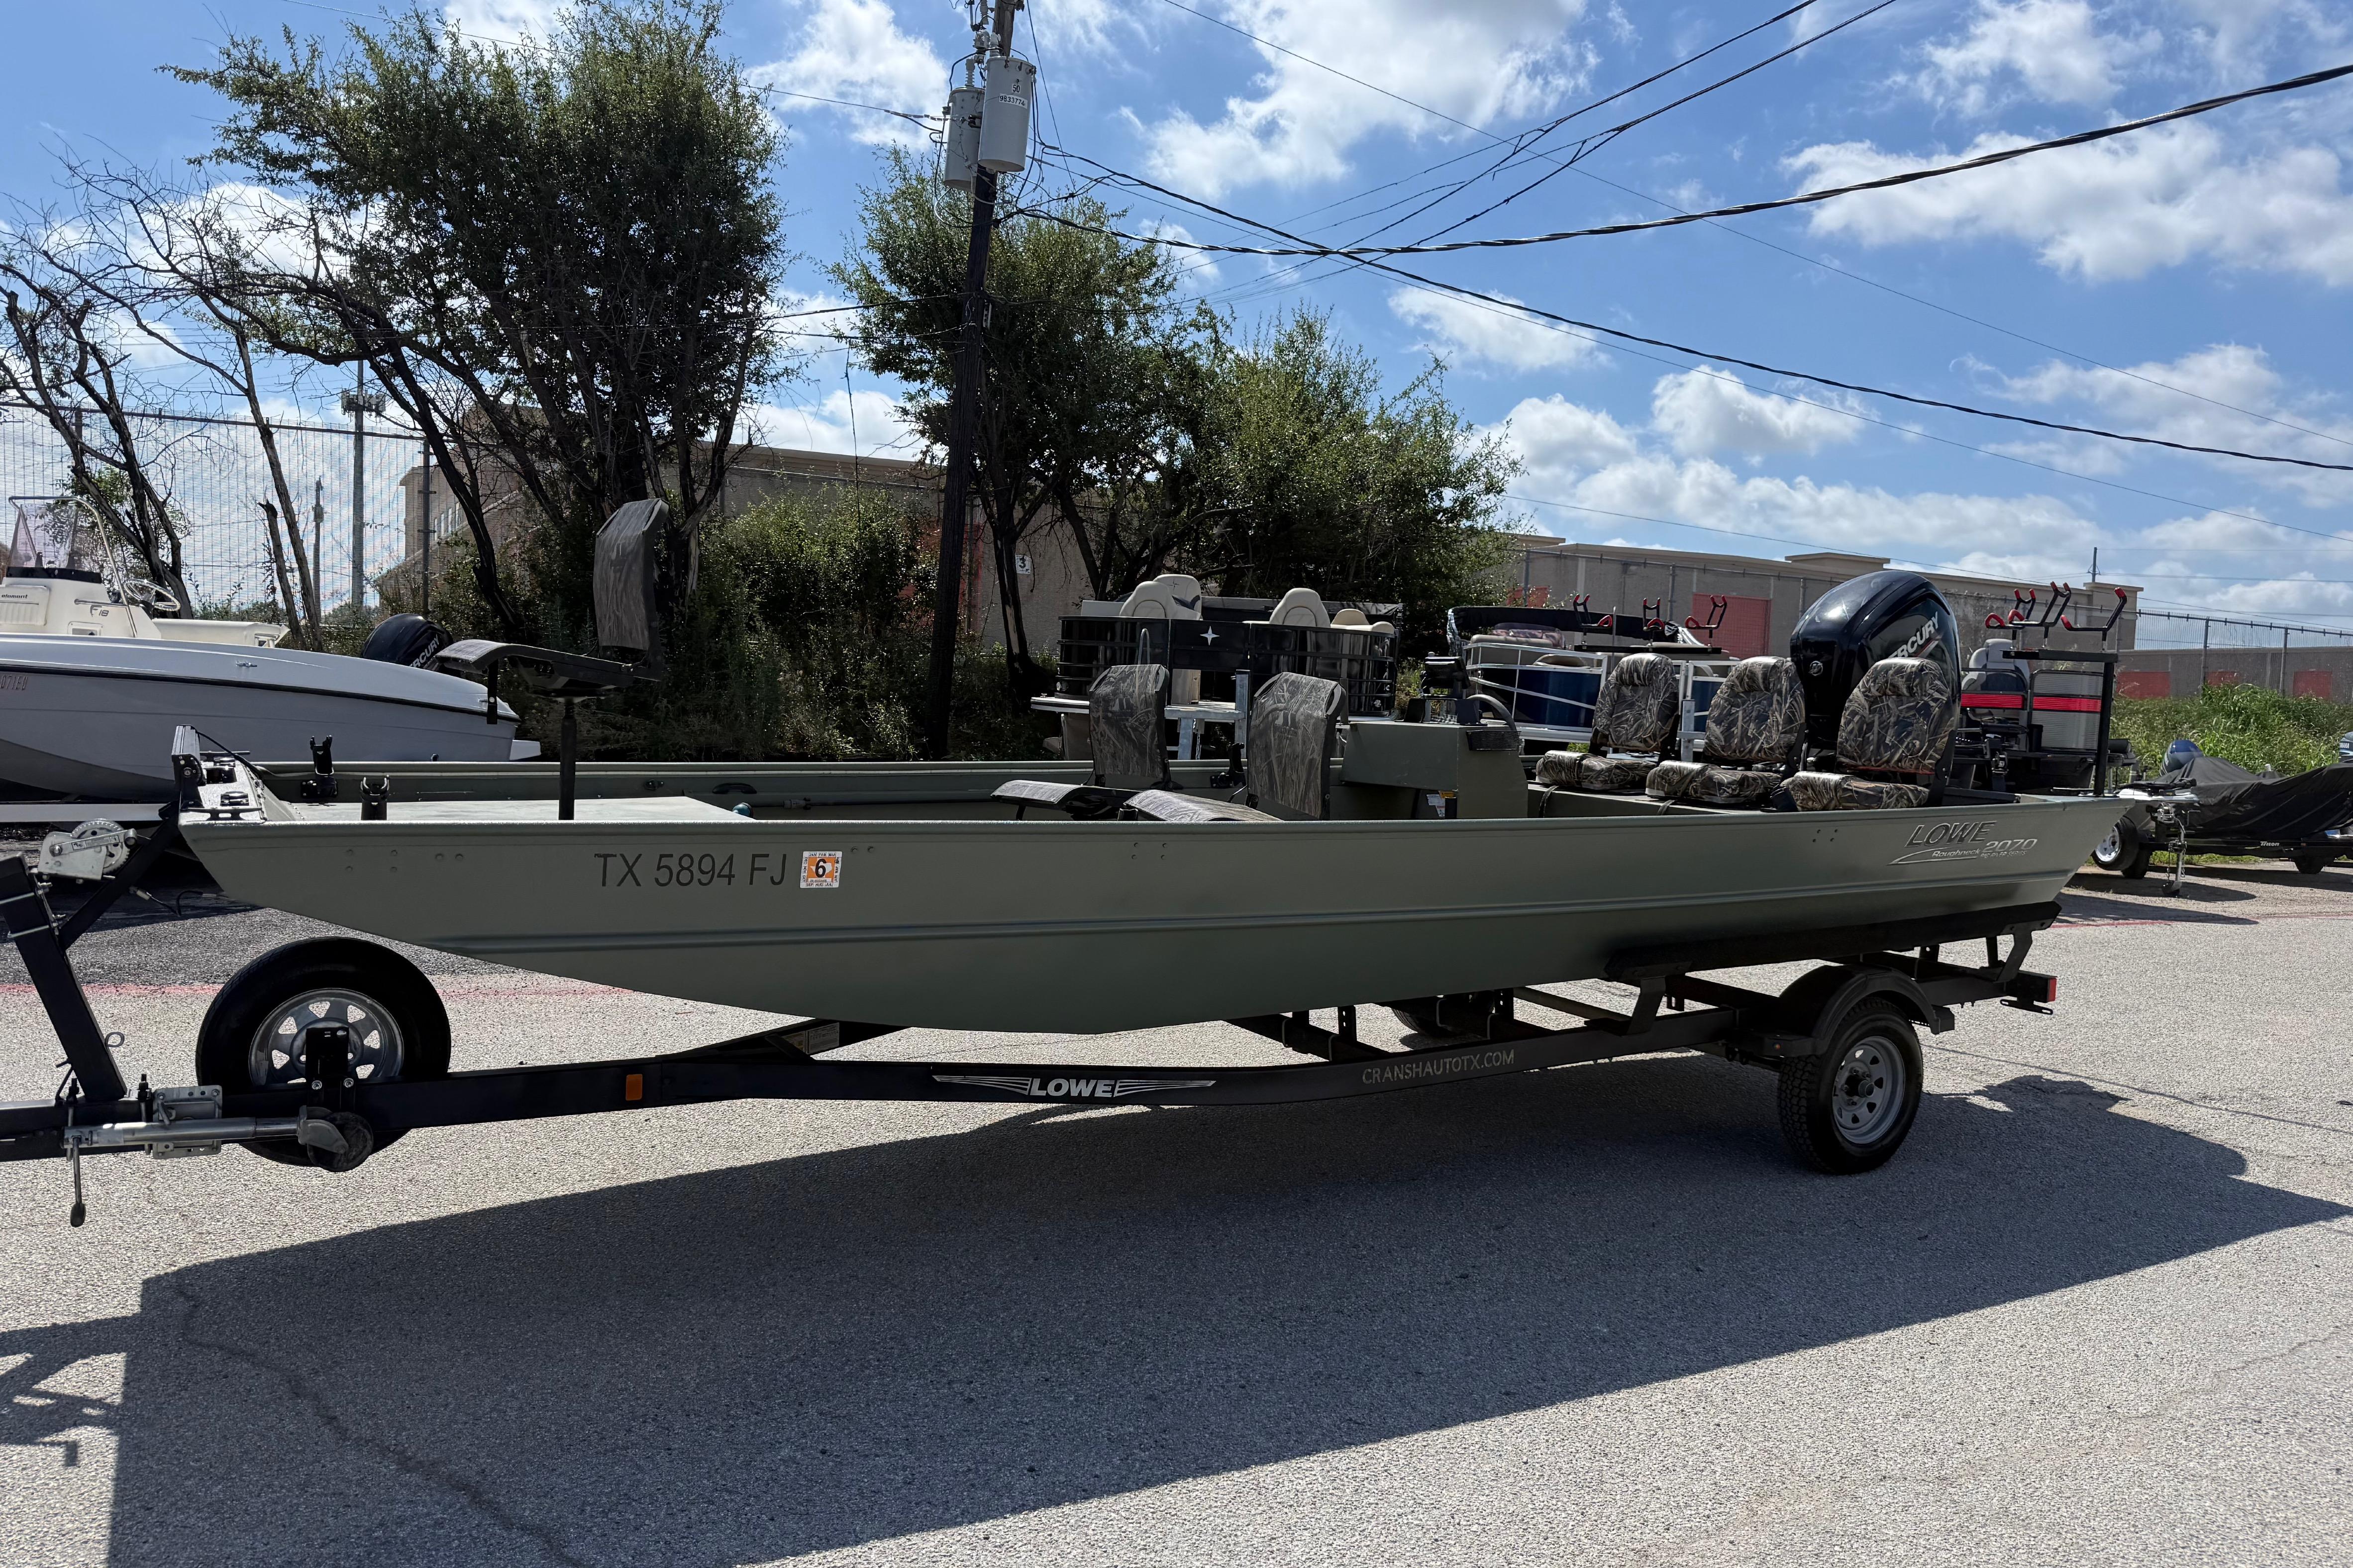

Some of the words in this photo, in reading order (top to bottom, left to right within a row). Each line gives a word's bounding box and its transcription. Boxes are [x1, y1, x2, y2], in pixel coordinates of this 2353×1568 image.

[1000, 96, 1024, 106] 9833774
[1019, 557, 1026, 569] 3
[1888, 611, 1938, 658] RCURY
[409, 634, 439, 667] RCURY
[1904, 821, 1997, 848] LOWE
[1932, 849, 1979, 857] Roughneck
[1982, 839, 2038, 852] 2070
[594, 853, 642, 887] TX
[654, 853, 735, 887] 5894
[748, 853, 787, 886] FJ
[815, 858, 826, 878] 6
[1362, 1049, 1515, 1084] CRANSHAUTOTX.COM
[1030, 1078, 1115, 1097] LOWE
